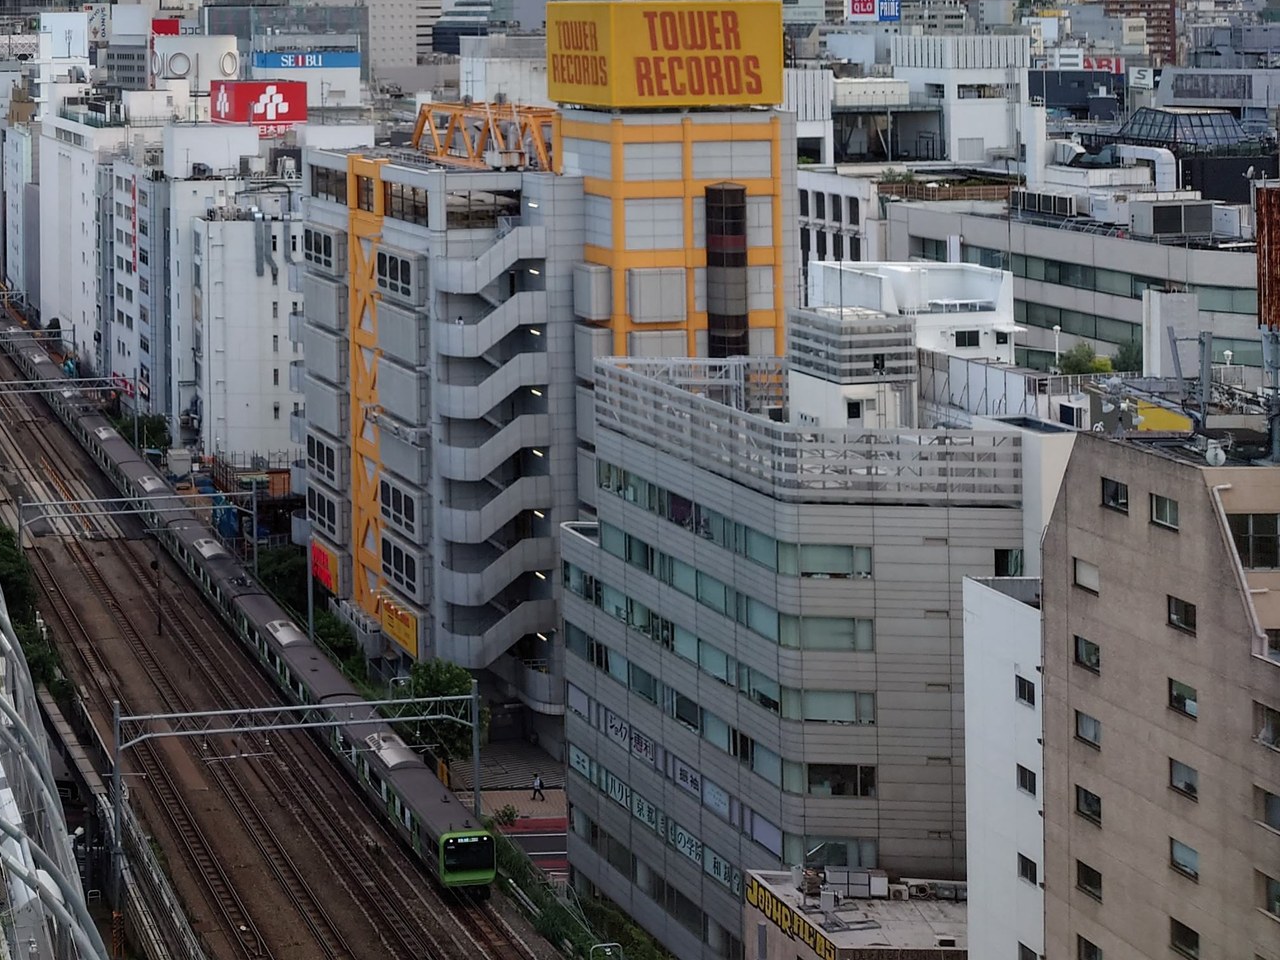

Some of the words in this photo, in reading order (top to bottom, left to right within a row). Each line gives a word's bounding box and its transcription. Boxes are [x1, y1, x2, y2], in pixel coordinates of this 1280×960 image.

[853, 2, 873, 14] QLO
[880, 1, 899, 17] PRIME
[555, 21, 599, 52] TOWER
[643, 10, 741, 51] TOWER
[281, 54, 322, 67] SEIBU
[552, 54, 608, 87] RECORDS
[634, 55, 763, 97] RECORDS
